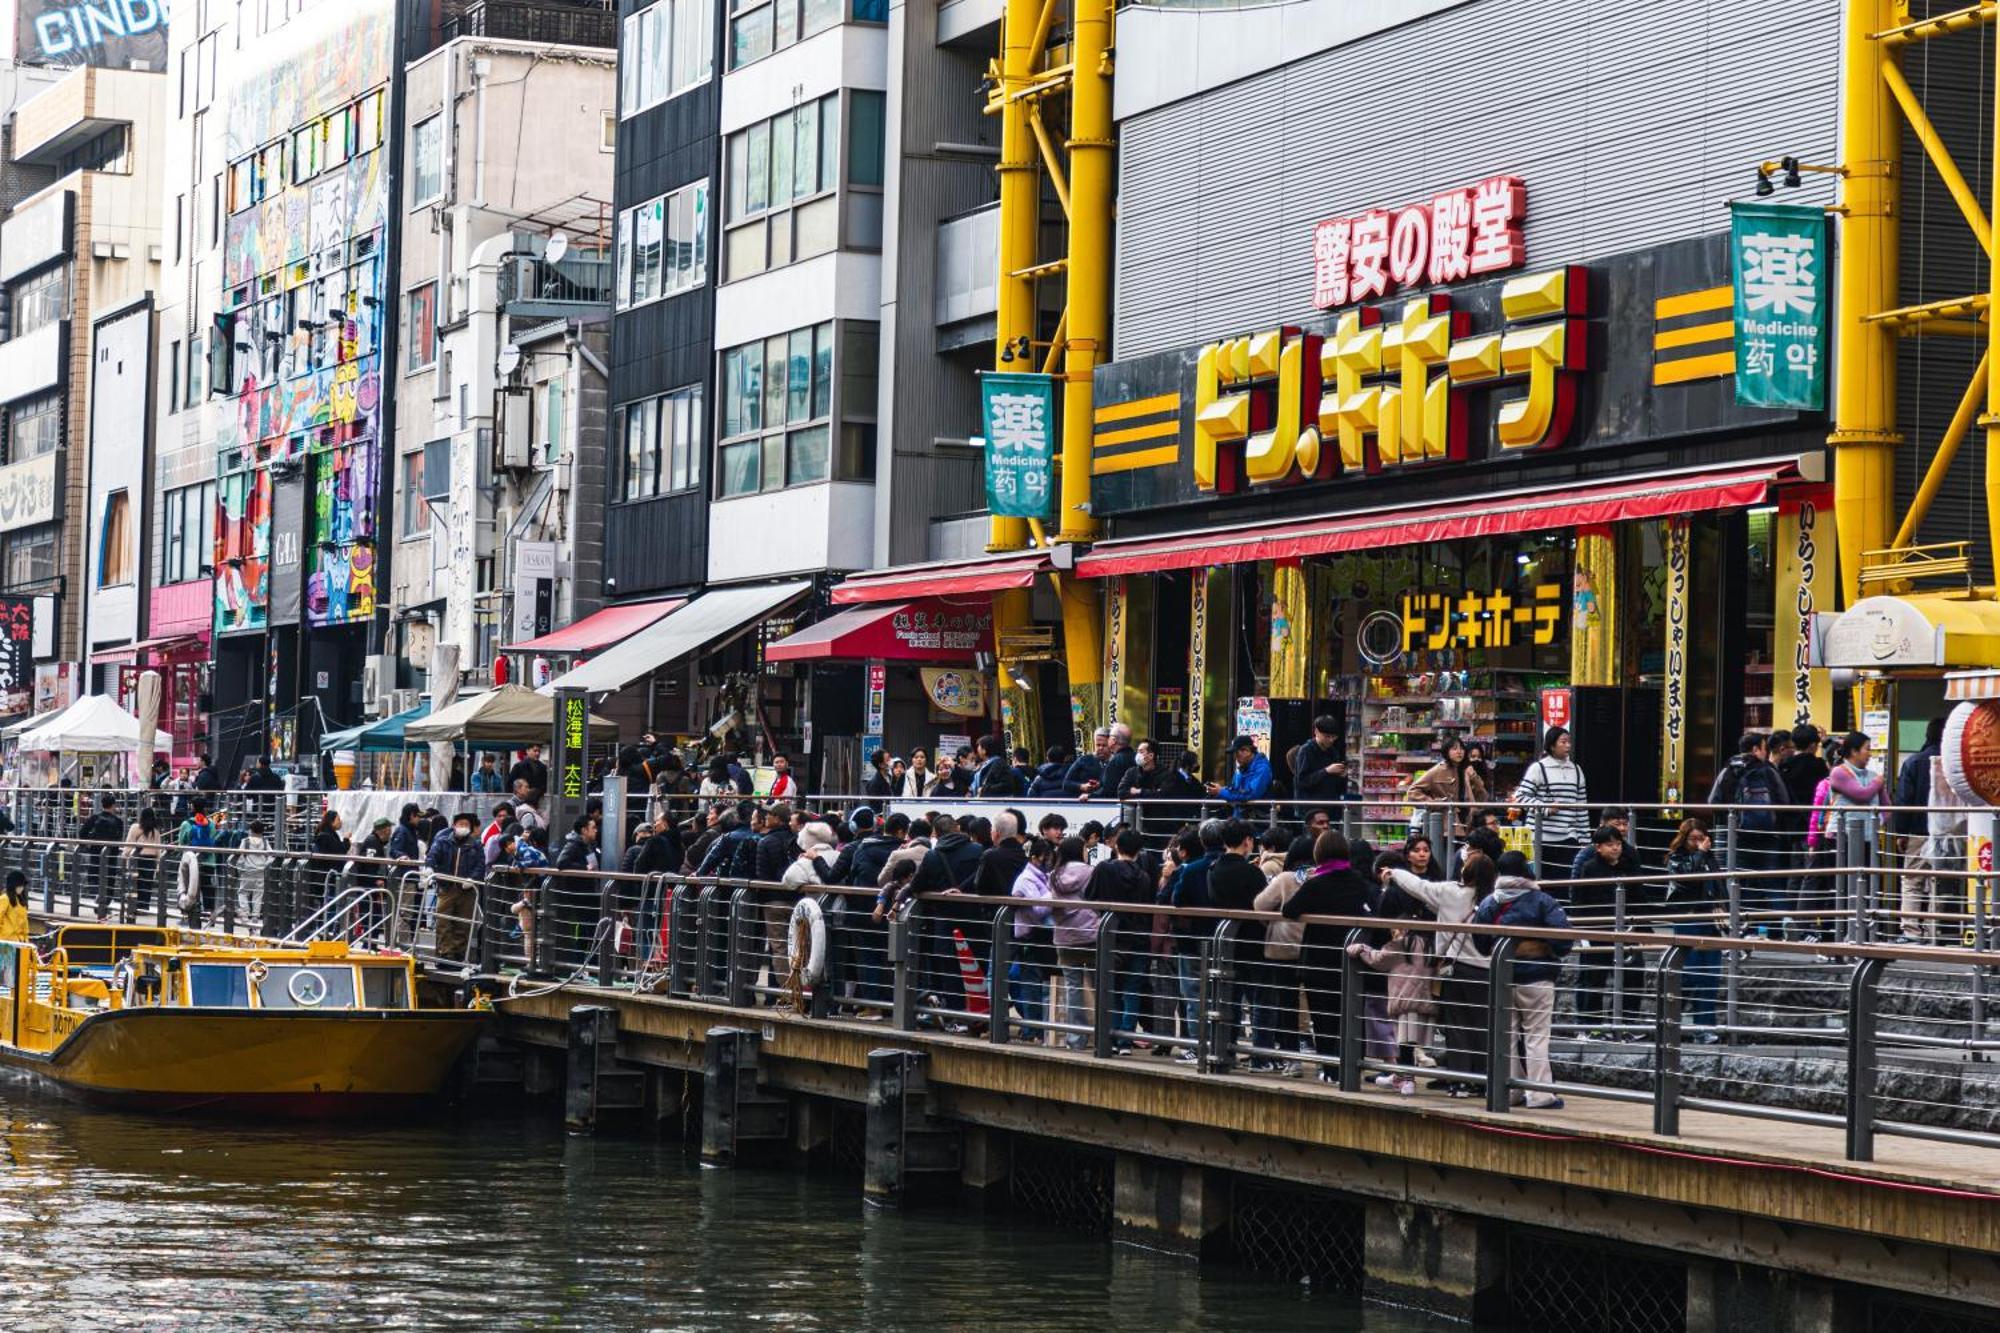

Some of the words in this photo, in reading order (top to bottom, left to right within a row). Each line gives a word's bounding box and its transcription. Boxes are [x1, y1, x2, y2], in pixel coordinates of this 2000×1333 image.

[35, 0, 169, 54] CIND
[1313, 176, 1519, 309] 驚安の殿堂
[1742, 232, 1817, 315] 薬
[1743, 319, 1818, 337] Medicine
[1745, 338, 1776, 377] 药
[1785, 343, 1818, 381] 약
[990, 393, 1046, 451] 薬
[991, 453, 1047, 467] Medicine
[993, 467, 1017, 496] 药
[1024, 471, 1048, 496] 약
[566, 698, 584, 749] 松海運
[563, 763, 582, 798] 太左
